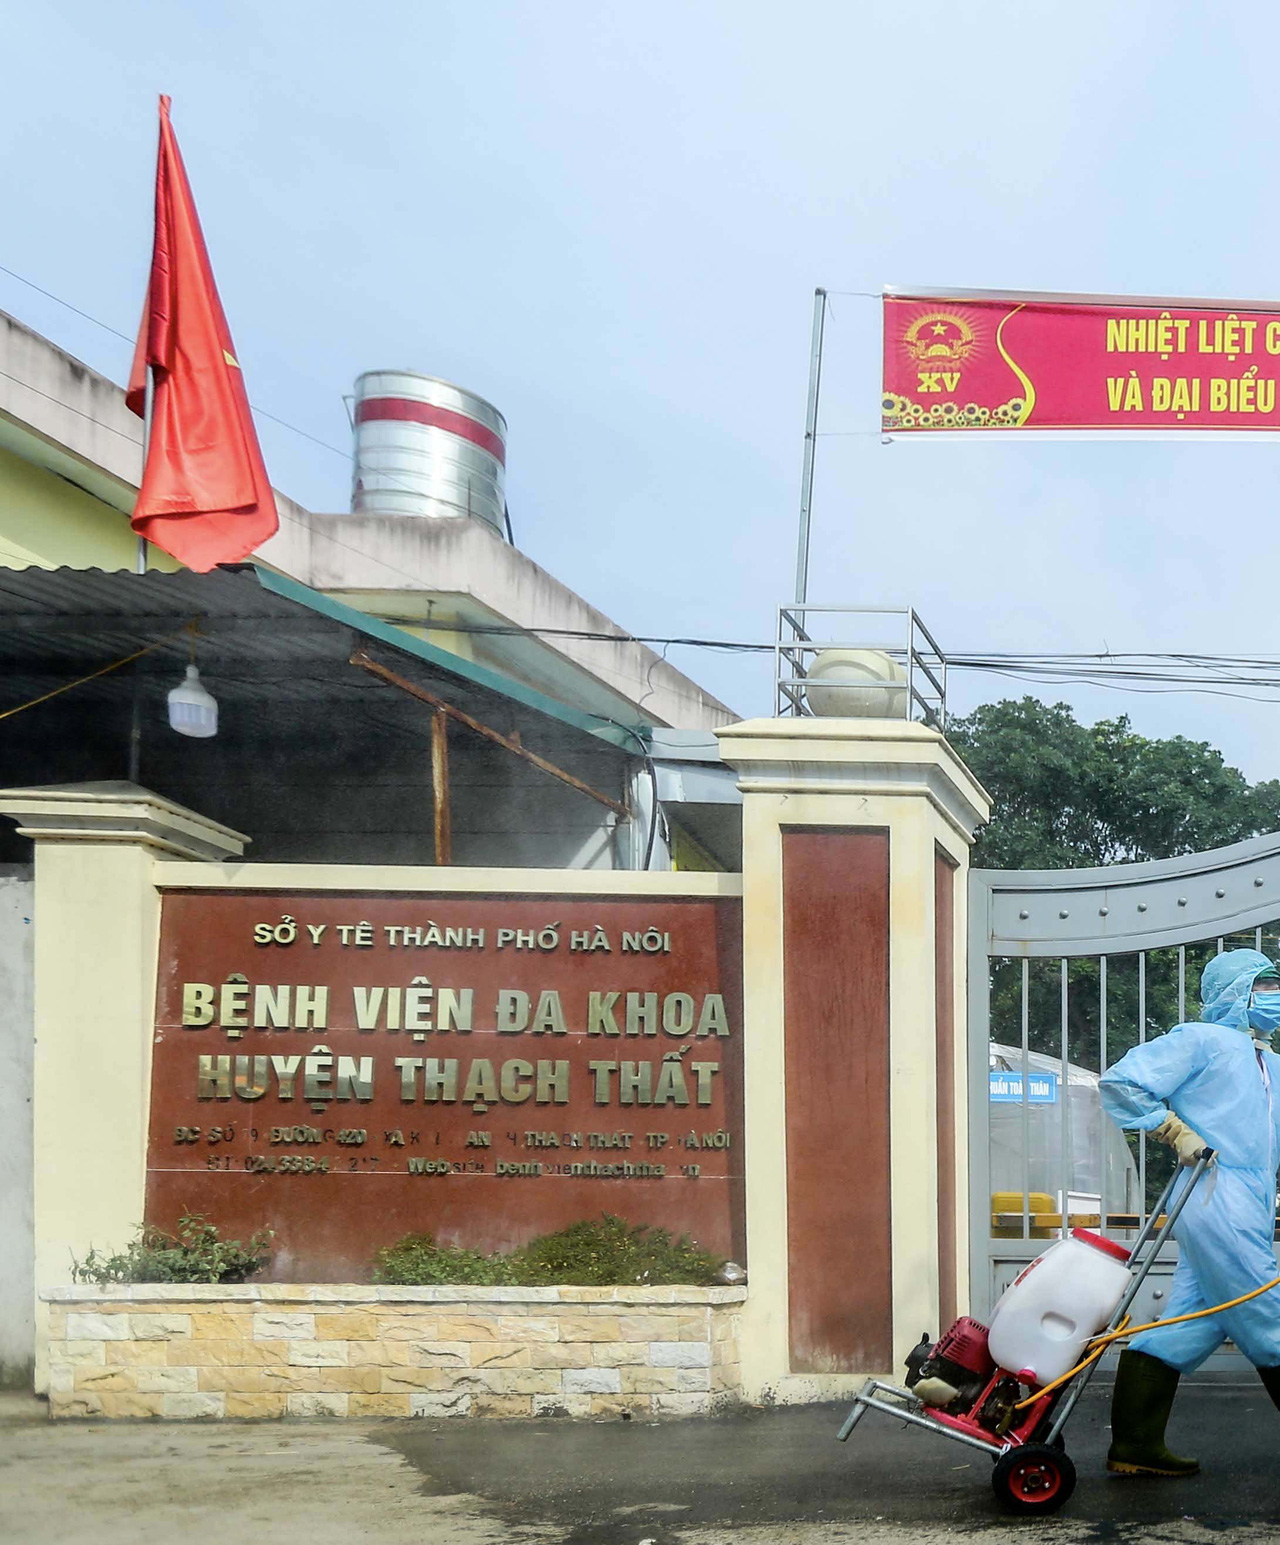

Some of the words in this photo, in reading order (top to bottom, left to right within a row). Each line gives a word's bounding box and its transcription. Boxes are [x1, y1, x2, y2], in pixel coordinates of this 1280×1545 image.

[1106, 312, 1190, 361] NHIỆT
[1198, 313, 1257, 362] LIỆT
[916, 372, 961, 393] XV
[1106, 369, 1144, 412] VÀ
[1151, 376, 1201, 421] ĐẠI
[1209, 365, 1276, 414] BIỂU
[253, 914, 299, 946] SỞ
[306, 923, 328, 945] Y
[383, 920, 486, 948] THÀNH
[496, 920, 562, 950] PHỐ
[569, 924, 613, 952] HÀ
[182, 973, 330, 1039] BỆNH
[353, 976, 475, 1042] VIỆN
[496, 988, 569, 1036] ĐA
[588, 990, 732, 1037] KHOA
[198, 1044, 375, 1112] HUYỆN
[395, 1056, 571, 1113] THẠCH
[588, 1045, 721, 1106] THẤT
